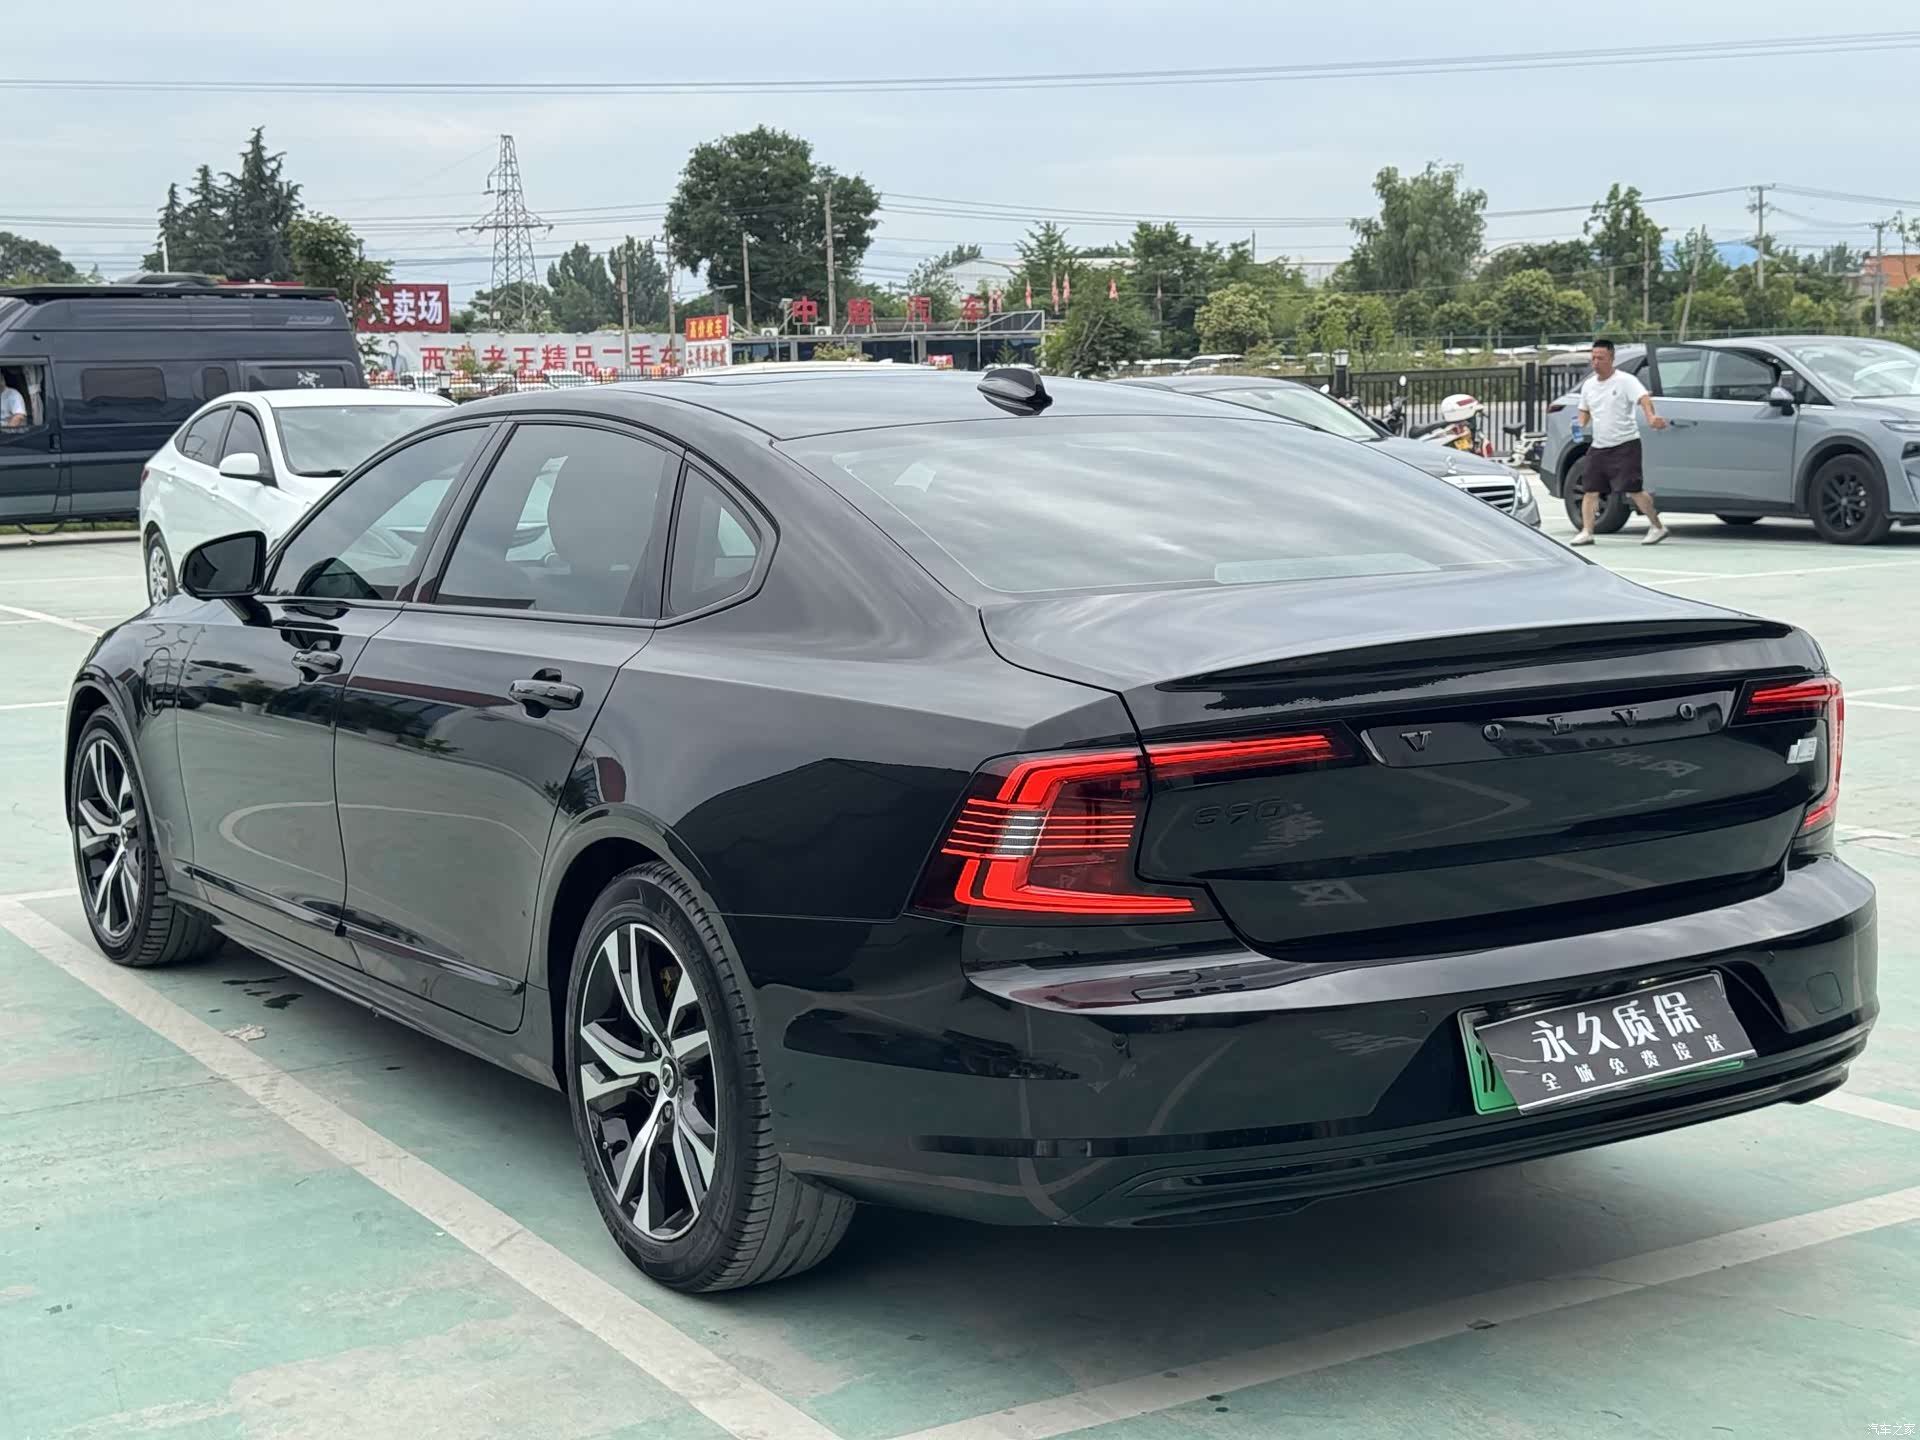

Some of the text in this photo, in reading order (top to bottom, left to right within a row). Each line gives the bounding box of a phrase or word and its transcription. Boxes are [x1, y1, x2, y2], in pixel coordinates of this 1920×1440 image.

[1400, 703, 1696, 752] VOLVO
[1194, 799, 1289, 827] S90
[1532, 991, 1702, 1063] 永久质保
[1541, 1034, 1726, 1091] 全城免费接送
